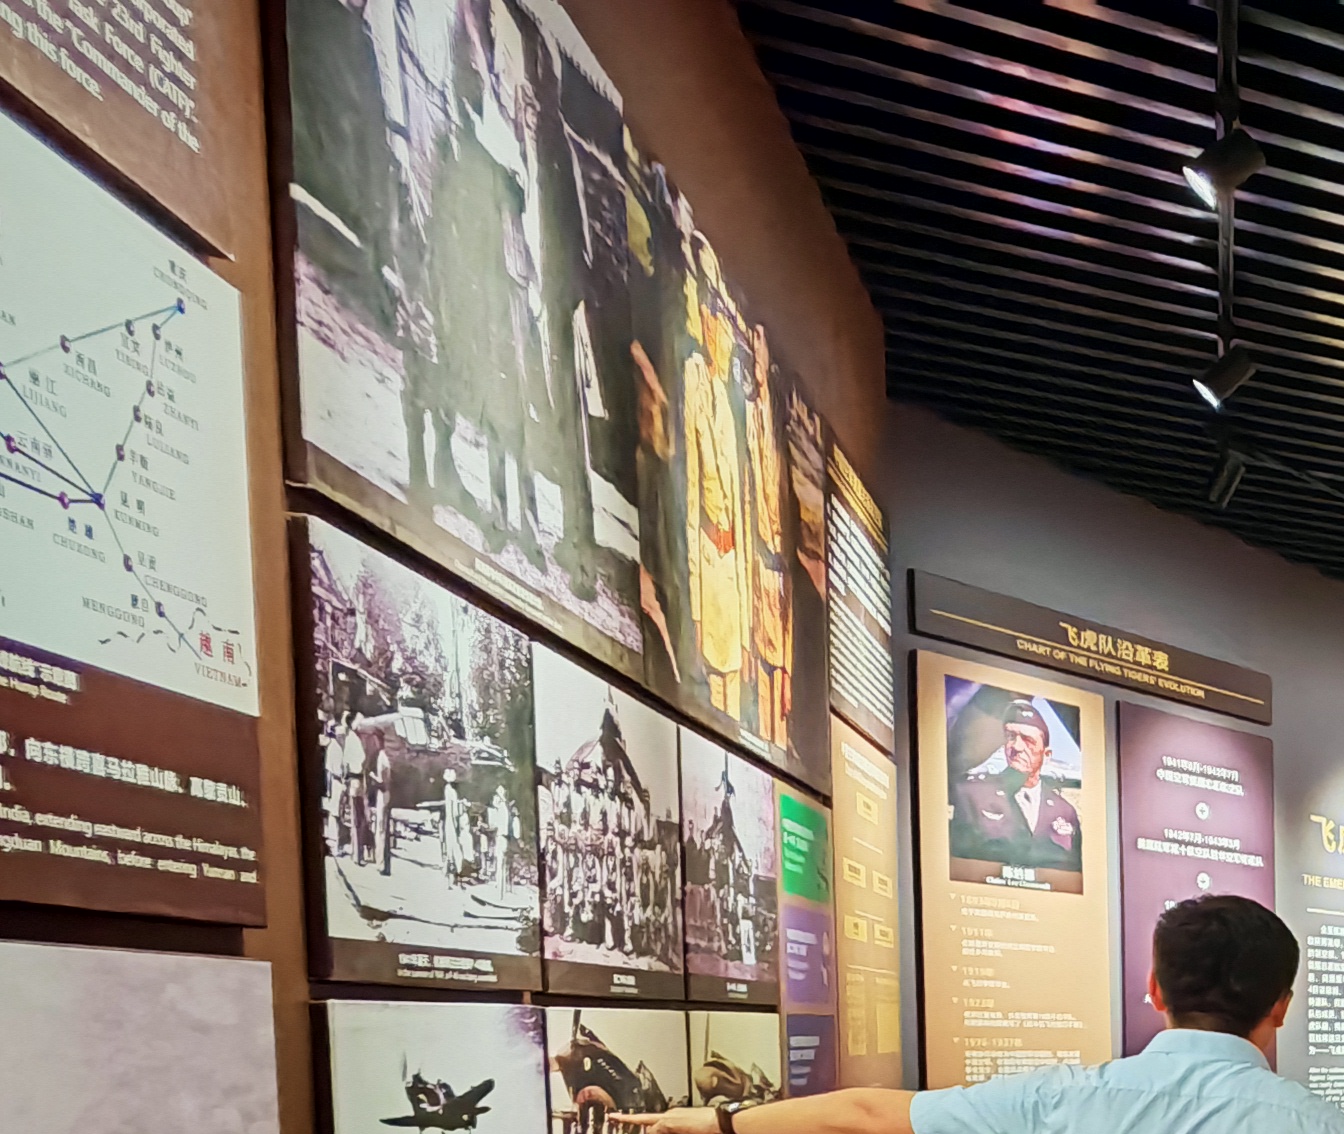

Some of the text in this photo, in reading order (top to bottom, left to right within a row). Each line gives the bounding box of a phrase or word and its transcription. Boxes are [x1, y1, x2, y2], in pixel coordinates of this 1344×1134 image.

[103, 21, 146, 74] Force
[150, 33, 197, 90] Fighter
[177, 121, 201, 154] the
[1015, 638, 1051, 658] CHART
[1052, 649, 1068, 662] OF
[1070, 652, 1088, 667] THE
[1089, 658, 1122, 677] FLYING
[1157, 678, 1206, 699] EVOLUTION
[1058, 620, 1170, 672] 飞虎队沿革表
[1301, 874, 1322, 888] THE
